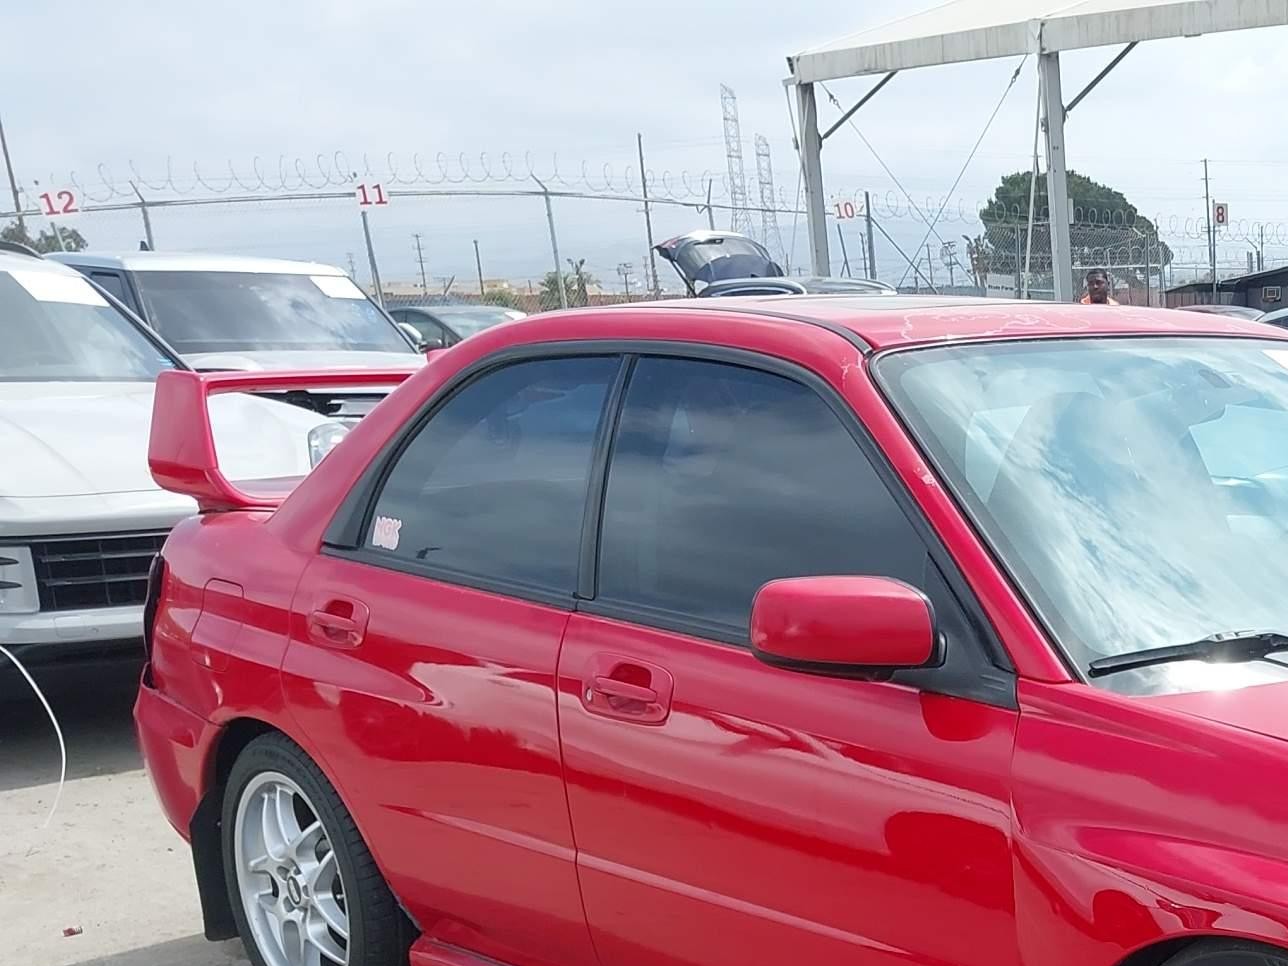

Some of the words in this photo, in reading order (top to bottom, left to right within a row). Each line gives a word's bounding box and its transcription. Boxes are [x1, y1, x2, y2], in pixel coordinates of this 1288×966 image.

[40, 190, 79, 215] 12
[357, 183, 387, 205] 11
[834, 202, 855, 219] 10
[1216, 206, 1225, 224] 8
